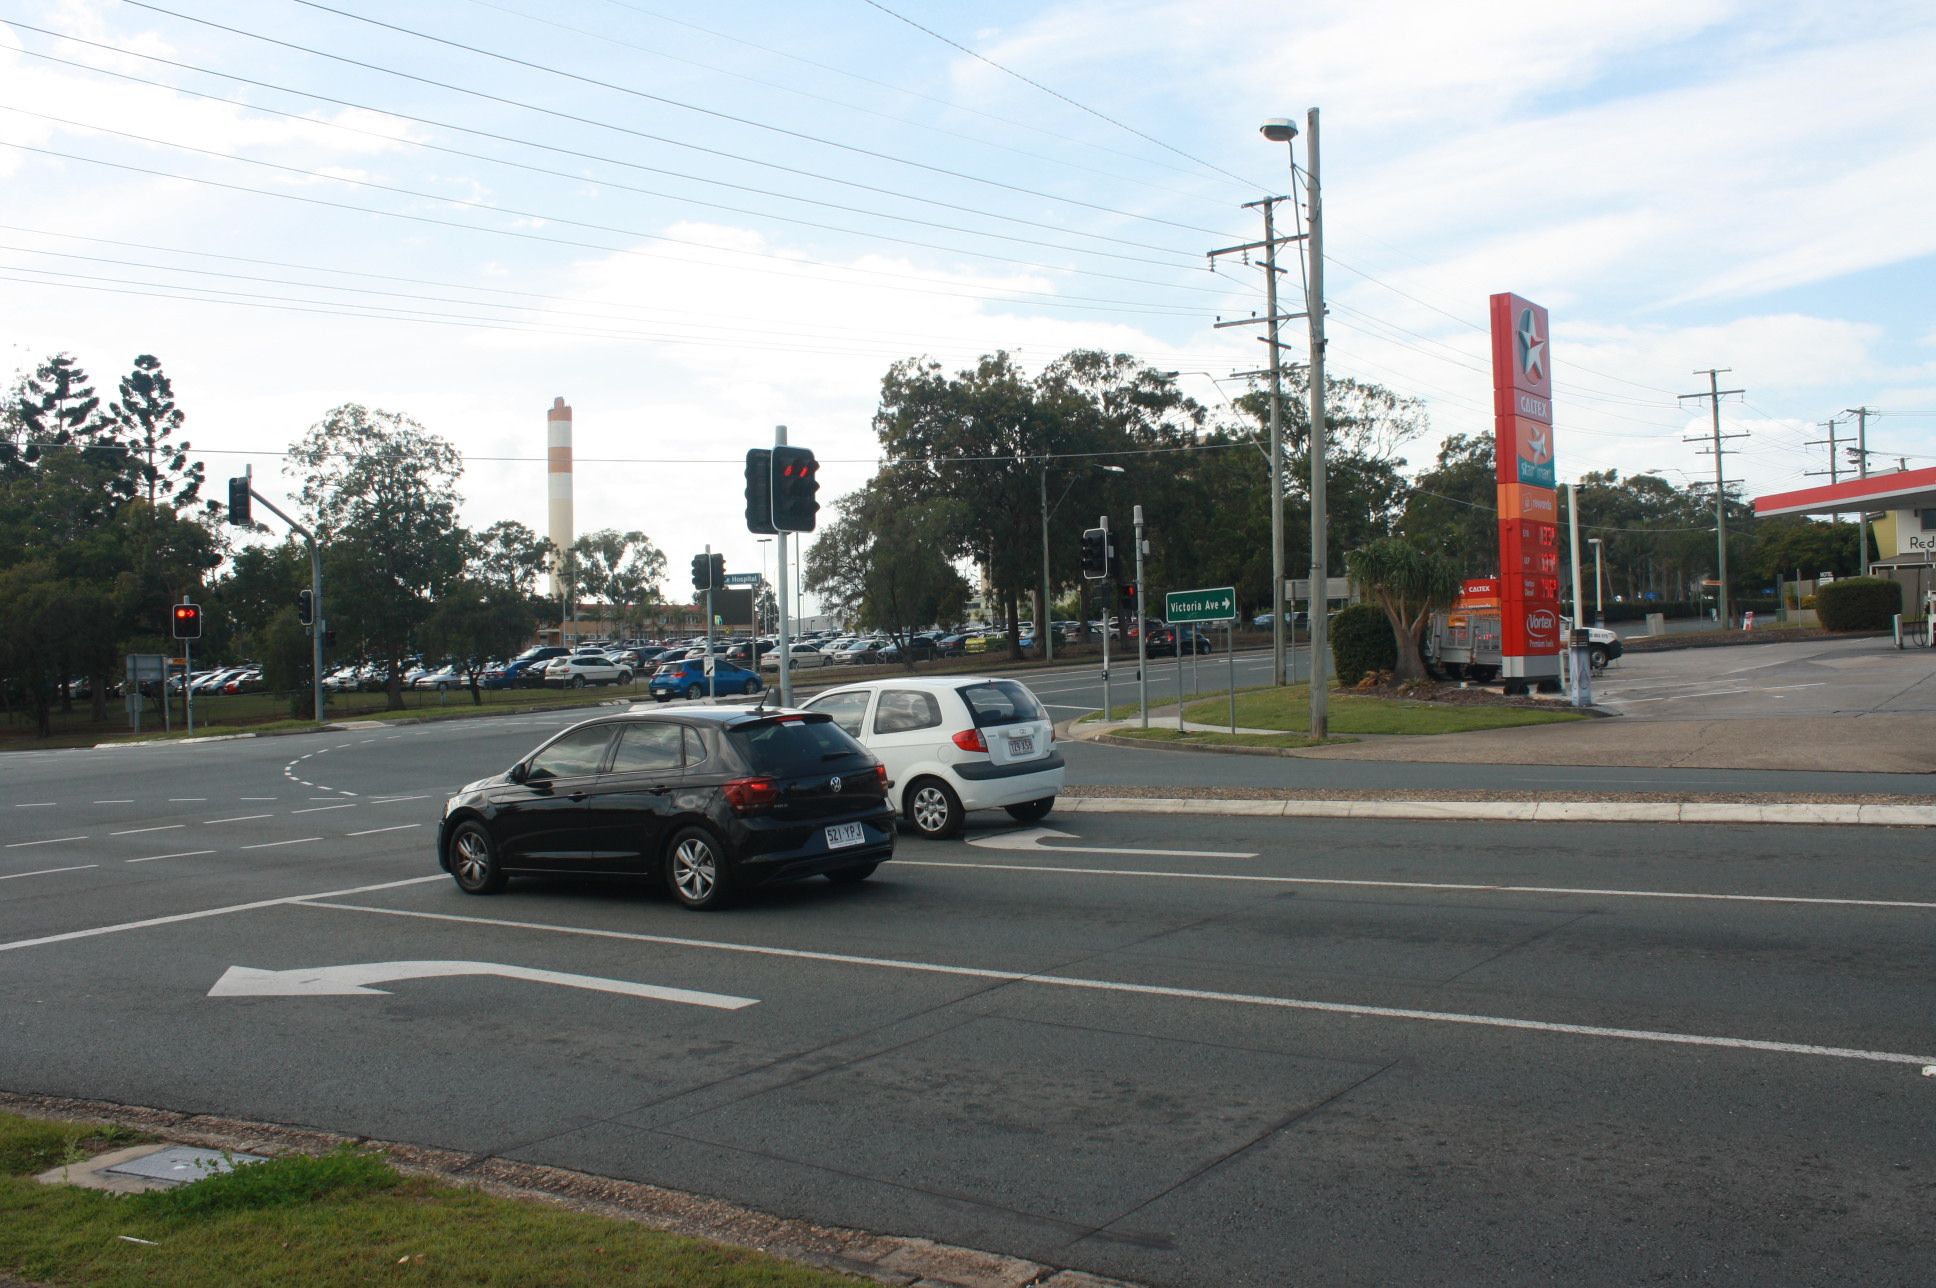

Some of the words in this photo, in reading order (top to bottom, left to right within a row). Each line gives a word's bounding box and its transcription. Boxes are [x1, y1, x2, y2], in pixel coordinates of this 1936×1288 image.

[1520, 396, 1547, 418] CALTEX
[1910, 536, 1936, 549] Red
[732, 575, 757, 583] Hospital
[1170, 601, 1202, 613] Victoria
[1205, 600, 1219, 610] Ave
[1529, 614, 1552, 629] Vortex
